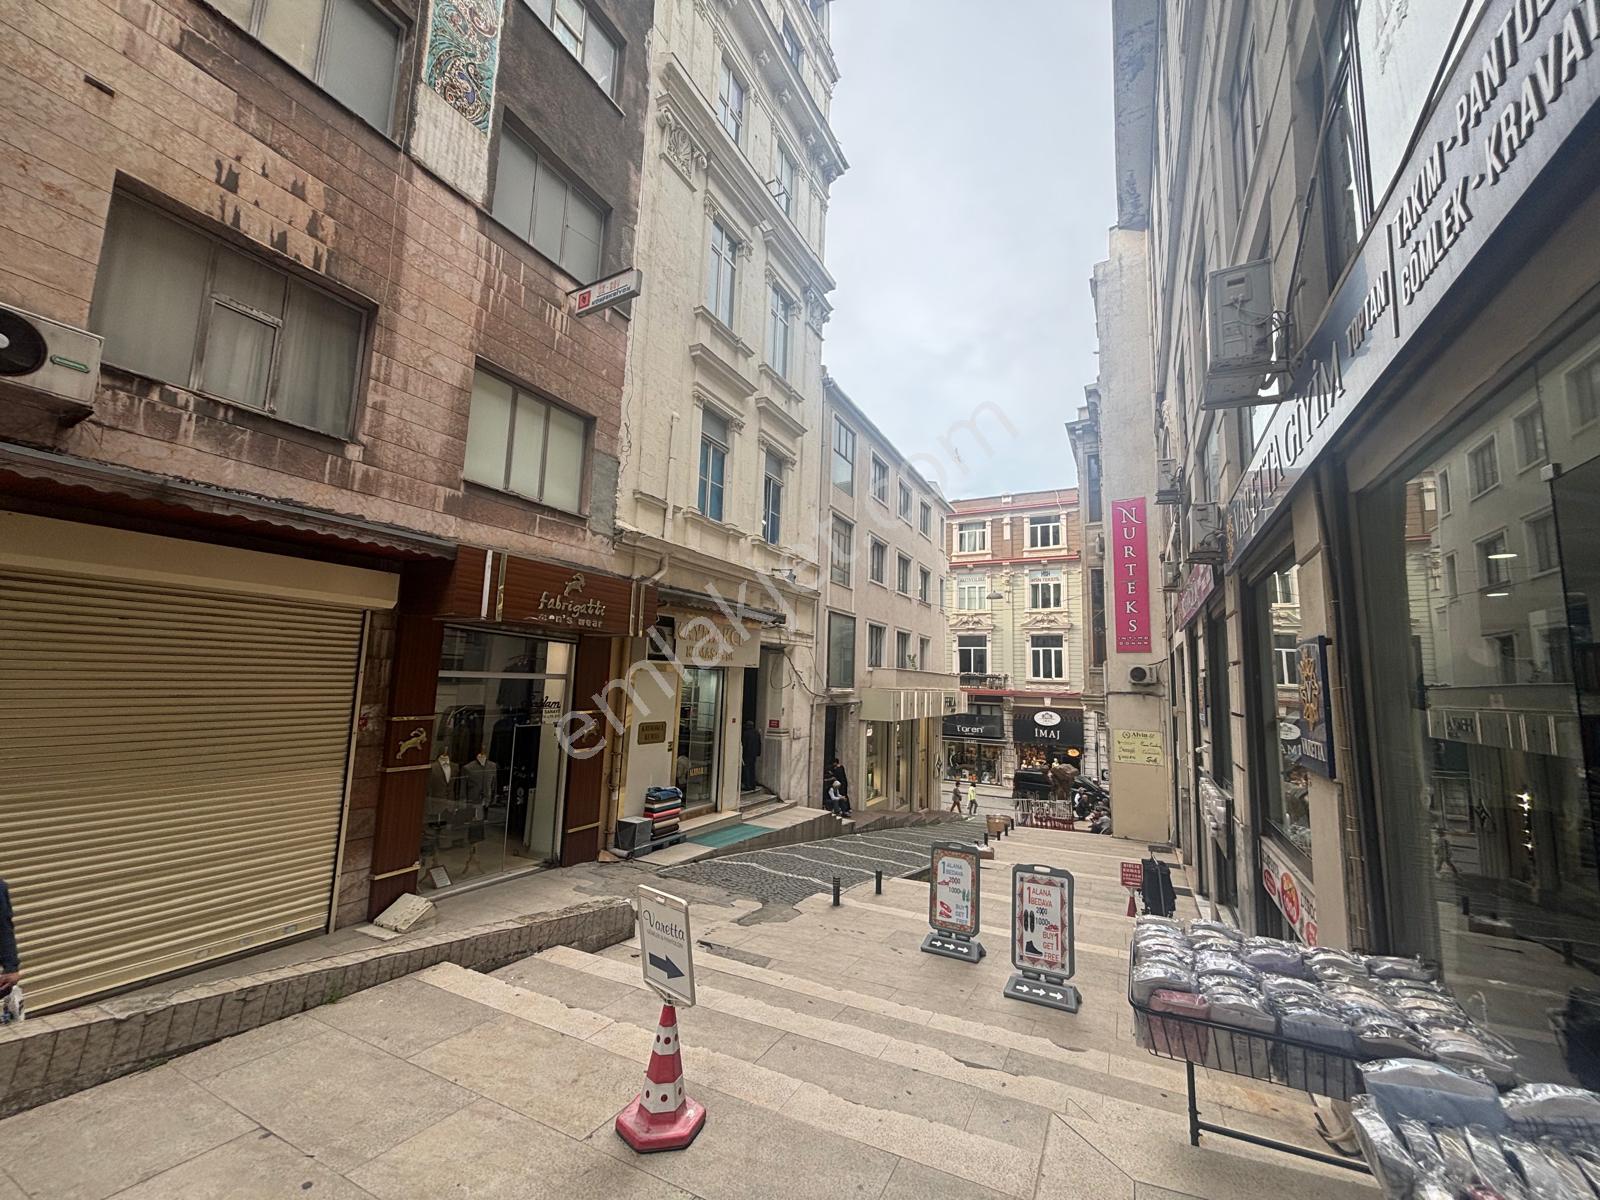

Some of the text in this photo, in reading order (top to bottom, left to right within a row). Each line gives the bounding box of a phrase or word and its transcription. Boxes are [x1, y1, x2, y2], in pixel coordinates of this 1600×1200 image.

[1393, 141, 1447, 249] TAKIM
[1402, 176, 1473, 306] GÖMLEK
[1346, 270, 1390, 357] TOPTAN
[1233, 340, 1347, 541] VARETTA GİYİM
[1117, 506, 1142, 632] NURTEKS
[1034, 727, 1060, 741] İMAJ
[1027, 886, 1052, 905] 1 ALANA
[1030, 897, 1053, 908] BEDAVA
[642, 909, 686, 941] Varetta
[1043, 931, 1054, 940] BUY
[1042, 941, 1054, 951] GET
[1043, 953, 1060, 963] FREE
